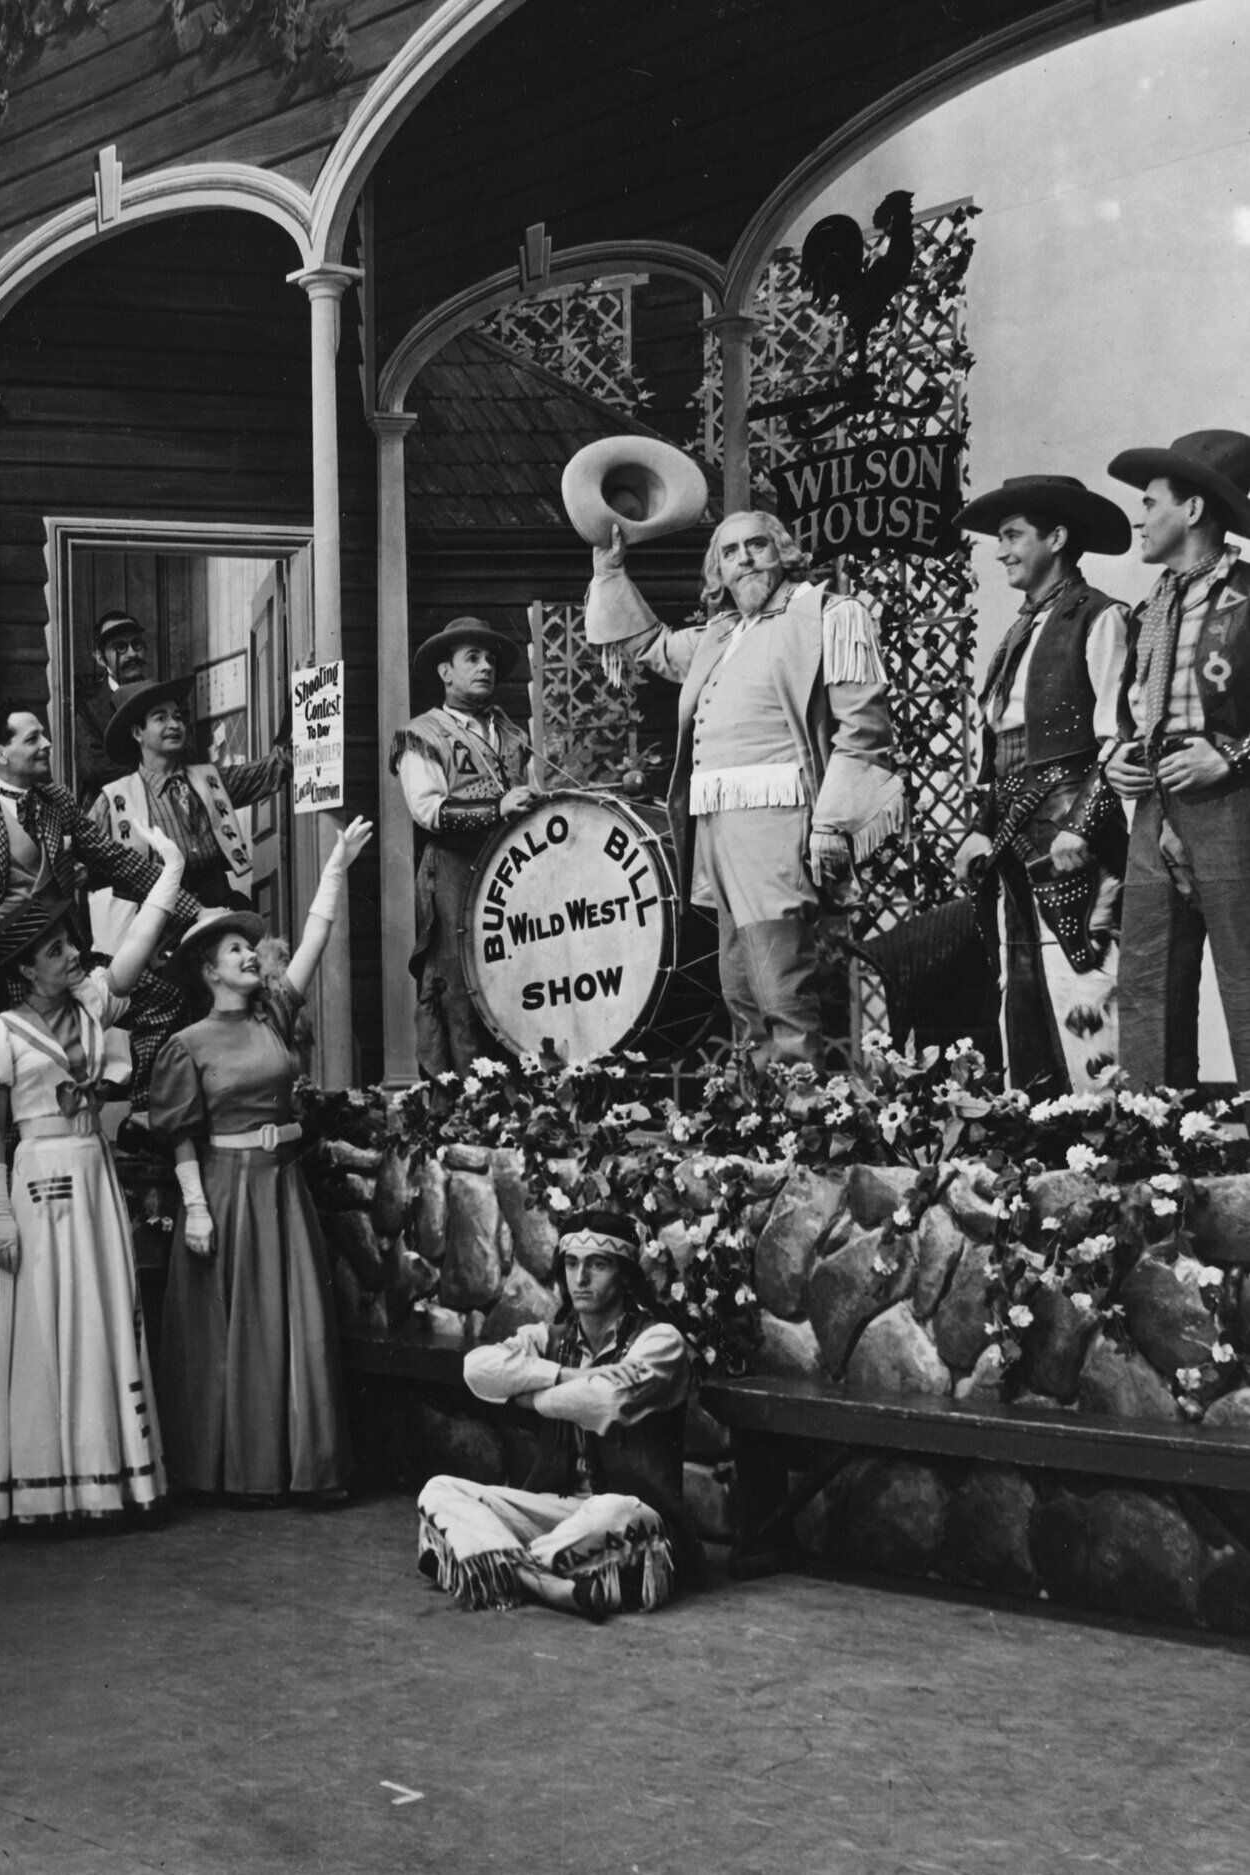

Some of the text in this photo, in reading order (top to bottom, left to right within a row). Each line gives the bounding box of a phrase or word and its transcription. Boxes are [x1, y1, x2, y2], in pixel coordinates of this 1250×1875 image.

[783, 443, 948, 509] WILSON
[791, 496, 941, 553] HOUSE
[295, 662, 339, 707] Shooting
[305, 694, 341, 721] Contest
[295, 776, 311, 804] Local
[482, 815, 658, 963] BUFFALO BILL
[522, 966, 623, 1010] SHOW
